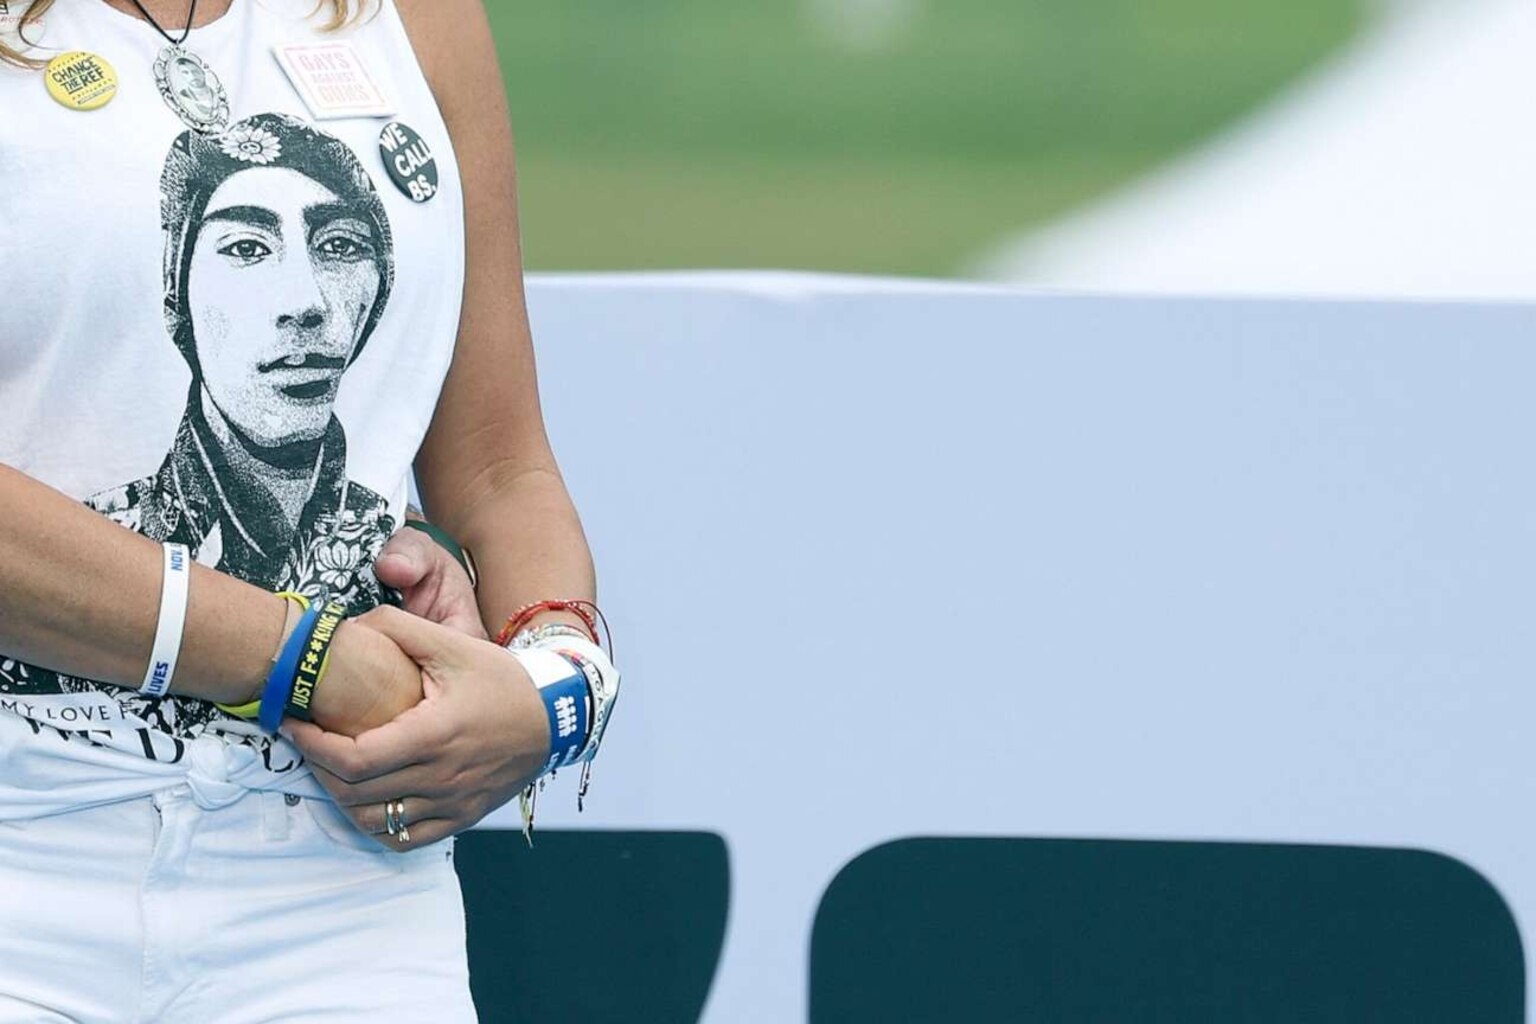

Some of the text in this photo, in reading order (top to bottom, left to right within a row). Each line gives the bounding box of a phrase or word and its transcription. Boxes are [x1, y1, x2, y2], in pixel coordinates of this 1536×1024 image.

[60, 65, 105, 92] THE REF
[379, 122, 408, 152] WE
[394, 139, 434, 177] CALL
[407, 174, 437, 202] BS.
[148, 661, 169, 694] LIVES
[292, 676, 314, 709] JUST
[0, 699, 35, 717] MY
[47, 704, 111, 721] LOVE
